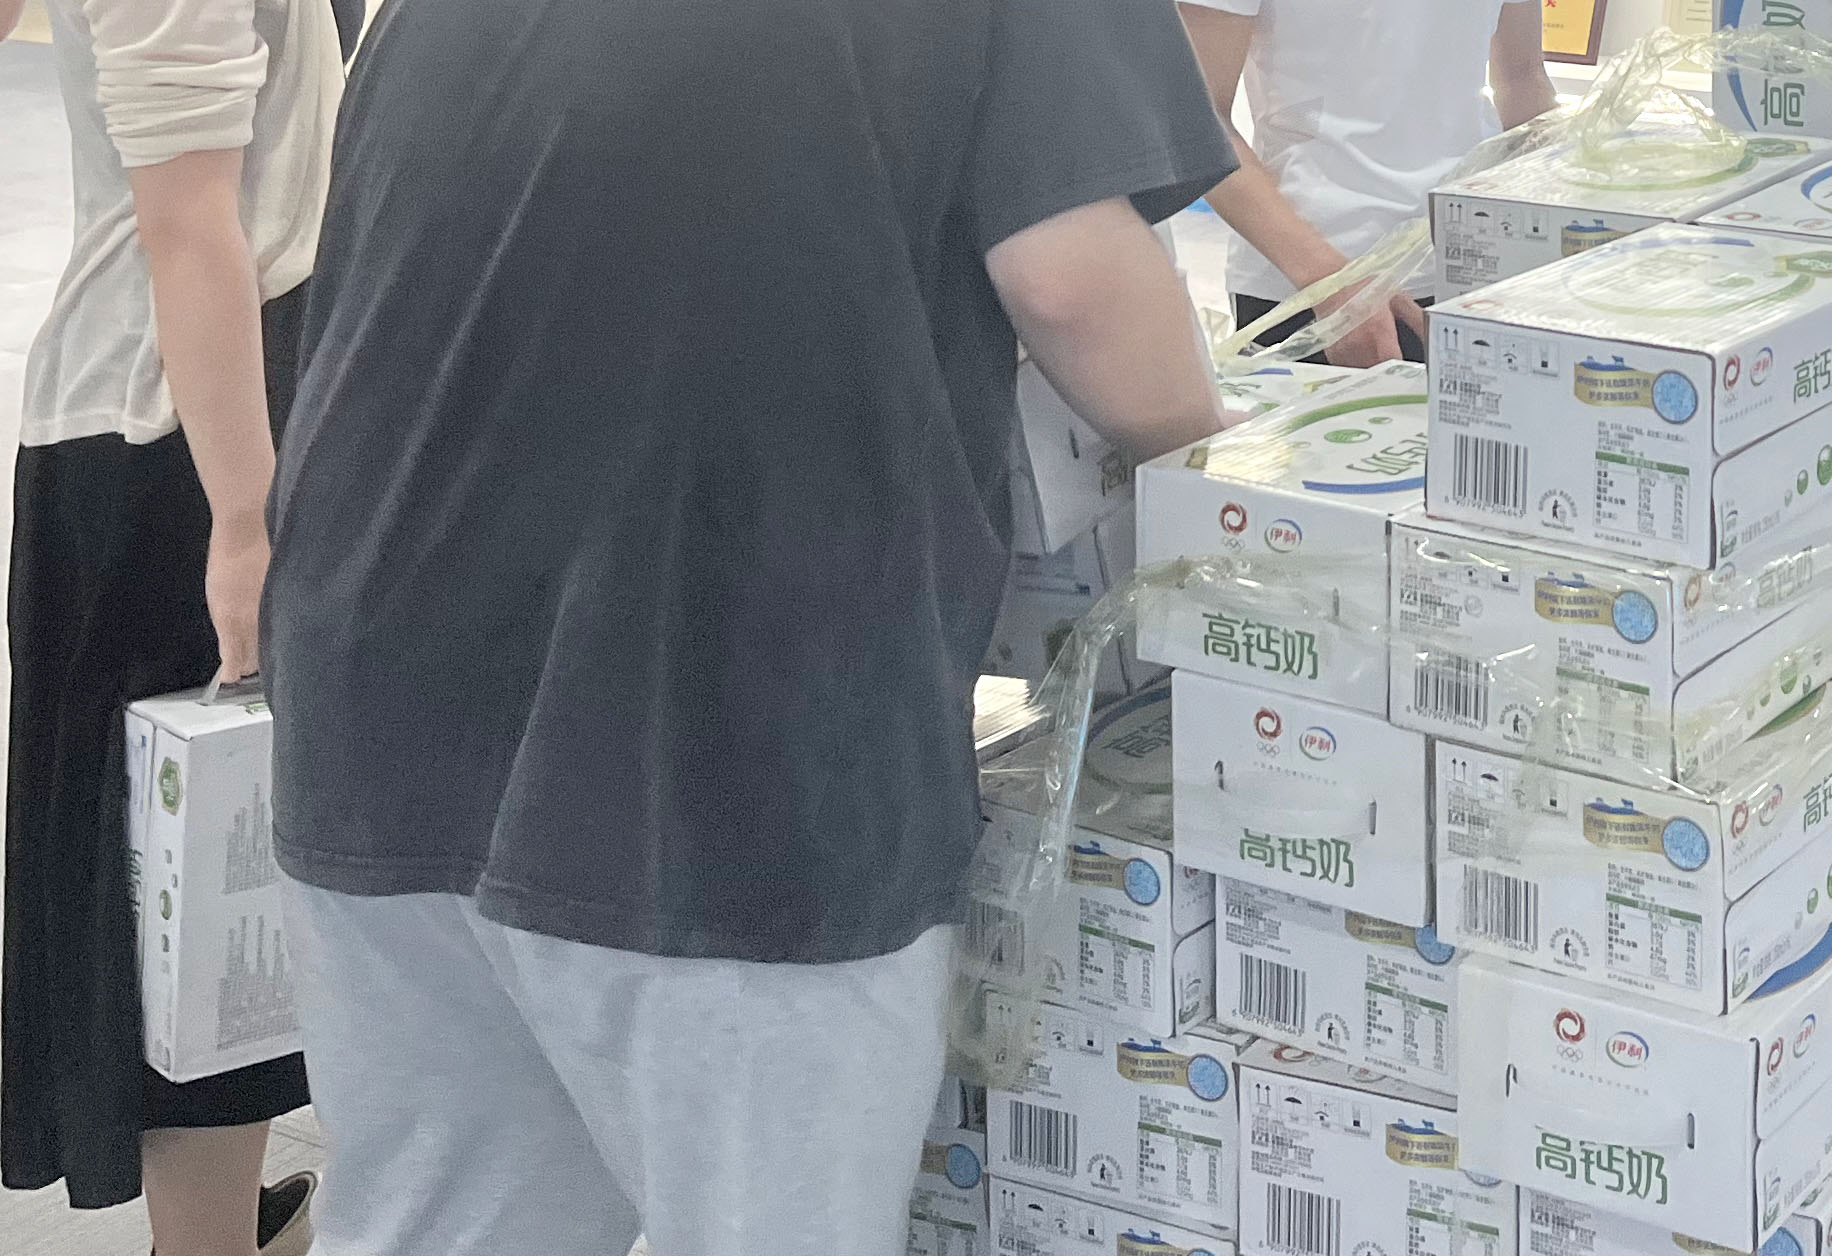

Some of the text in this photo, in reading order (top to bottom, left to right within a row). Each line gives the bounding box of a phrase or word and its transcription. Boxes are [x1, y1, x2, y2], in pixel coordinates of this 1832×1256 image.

[1269, 525, 1298, 544] 伊利
[1201, 611, 1319, 680] 高钙奶
[1304, 734, 1332, 753] 伊利
[1239, 827, 1355, 888] 高钙奶
[1611, 1039, 1643, 1061] 伊利
[1534, 1124, 1668, 1205] 高钙奶
